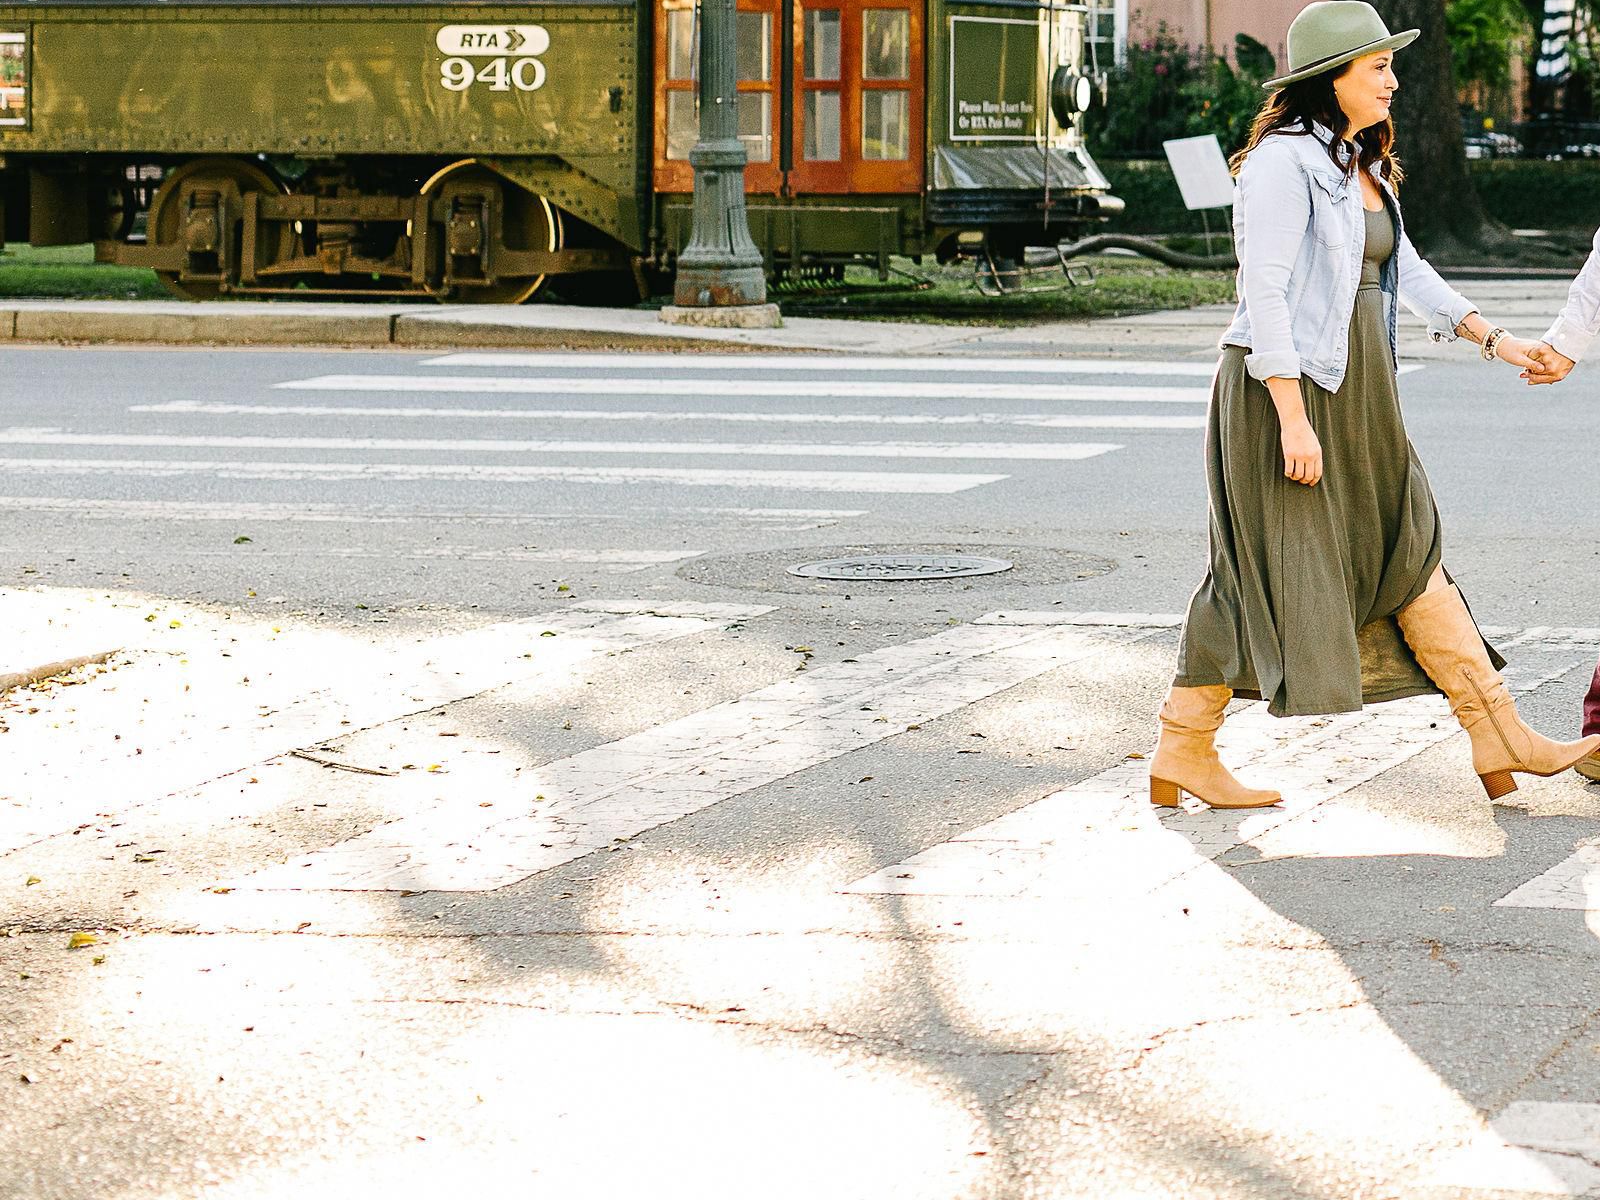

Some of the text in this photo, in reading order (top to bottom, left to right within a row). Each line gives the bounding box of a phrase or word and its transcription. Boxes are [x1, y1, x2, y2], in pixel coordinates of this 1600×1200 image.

[460, 33, 498, 48] RTA
[440, 57, 546, 91] 940
[959, 100, 982, 114] Please
